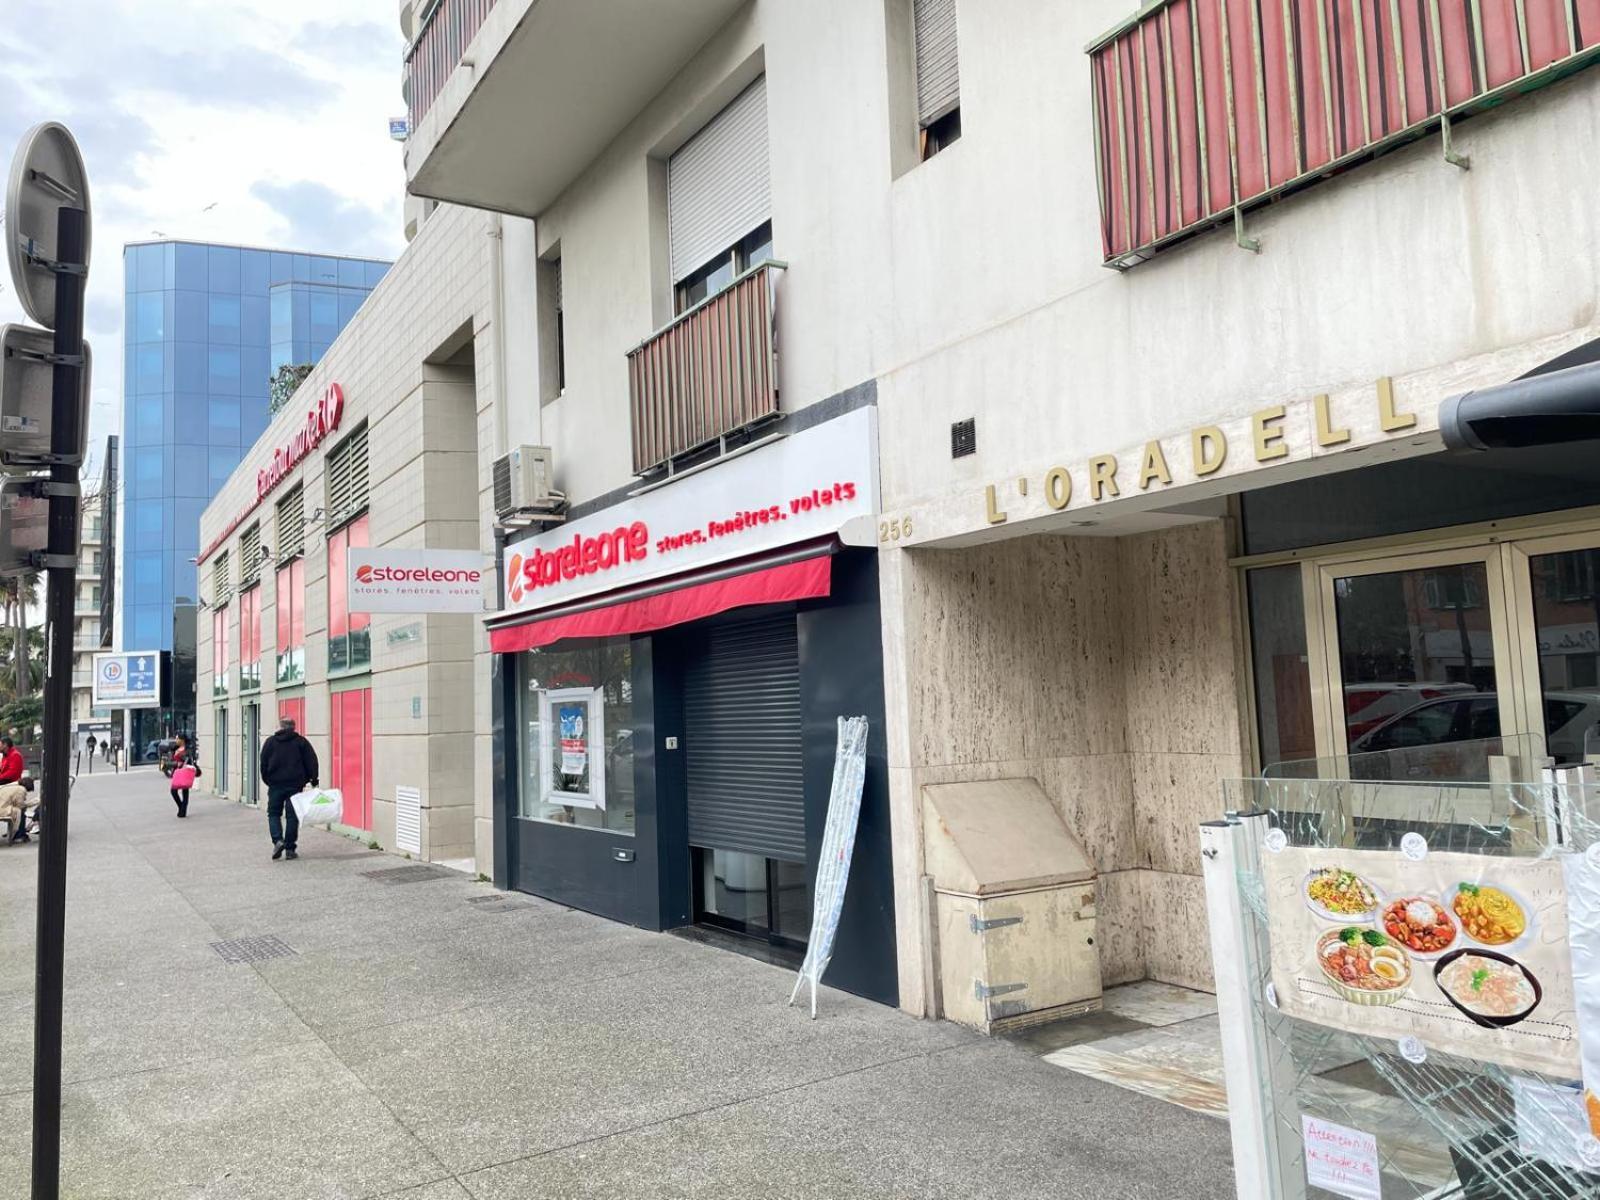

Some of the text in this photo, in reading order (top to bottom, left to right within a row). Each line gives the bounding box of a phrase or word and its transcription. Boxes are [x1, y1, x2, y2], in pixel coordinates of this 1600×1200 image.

[523, 482, 857, 592] storeleone stores. fenêtres. volets
[879, 515, 913, 542] 256
[373, 566, 481, 583] storeleone
[448, 587, 480, 595] volets
